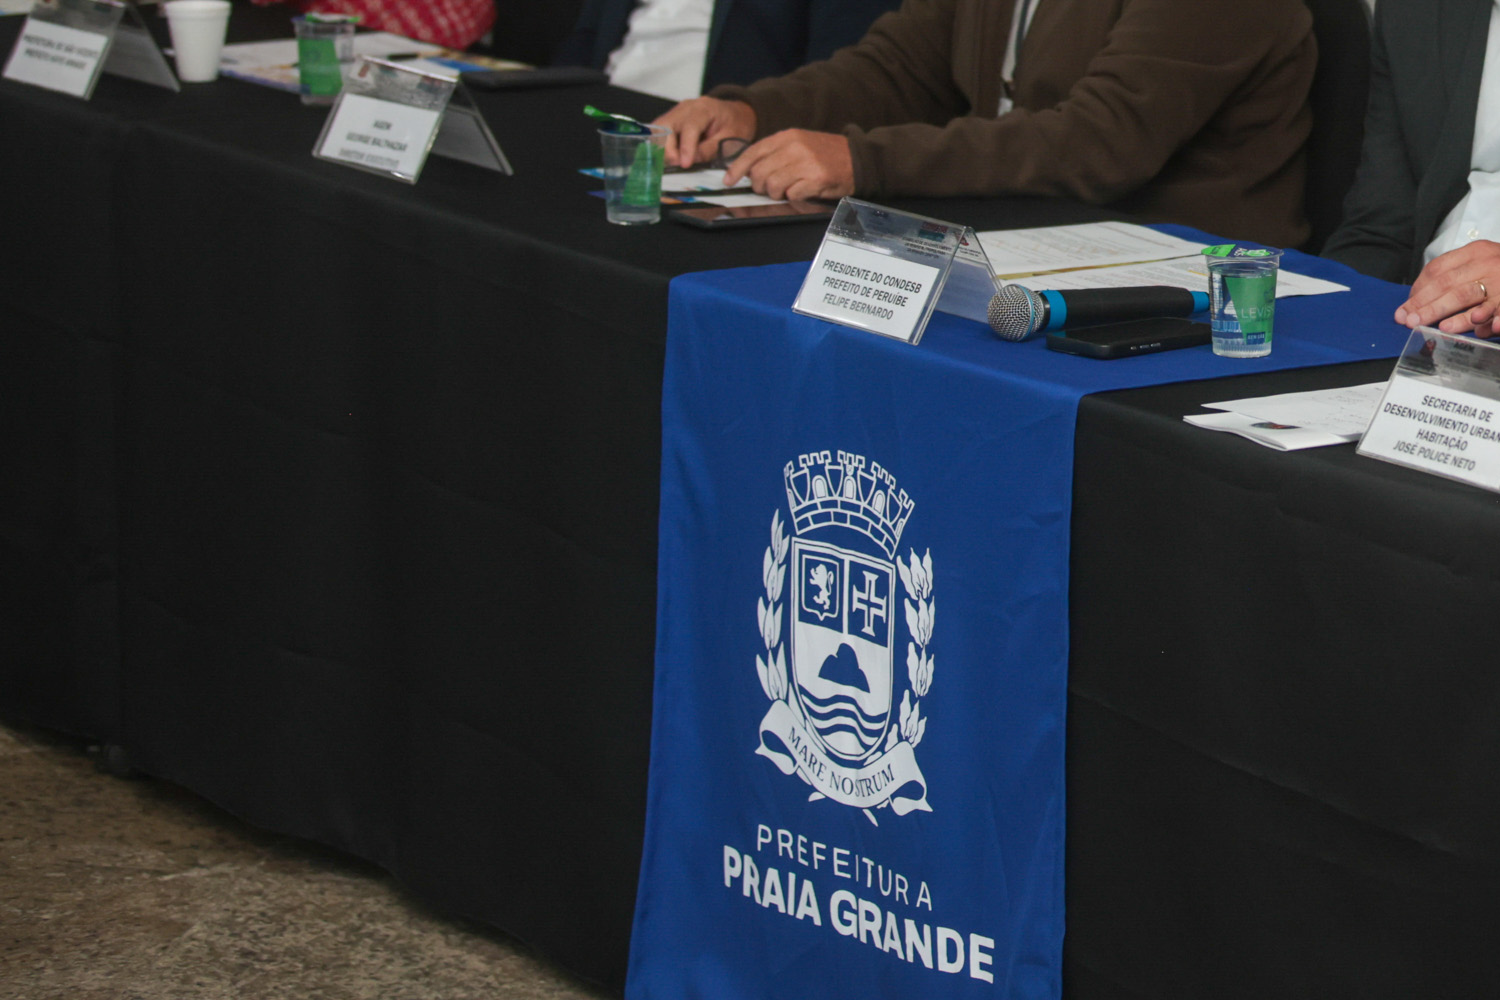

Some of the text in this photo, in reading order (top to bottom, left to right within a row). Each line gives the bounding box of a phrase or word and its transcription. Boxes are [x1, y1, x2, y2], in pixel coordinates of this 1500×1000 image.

[822, 259, 922, 294] PRESIDENTE DO CONDESB
[823, 276, 909, 307] PREFEITO DE PERUÍBE
[822, 293, 894, 320] FELIPE BERNARDO
[1384, 402, 1469, 433] DESENVOLVIMENTO
[1421, 395, 1493, 423] SECRETARIA DE
[1416, 428, 1468, 451] HABITAÇÃO
[1393, 440, 1476, 471] JOSÉ POLICE NETO
[788, 726, 895, 798] MARE NOSTRUM
[757, 824, 933, 912] PREFEITURA
[723, 844, 995, 984] PRAIA GRANDE
